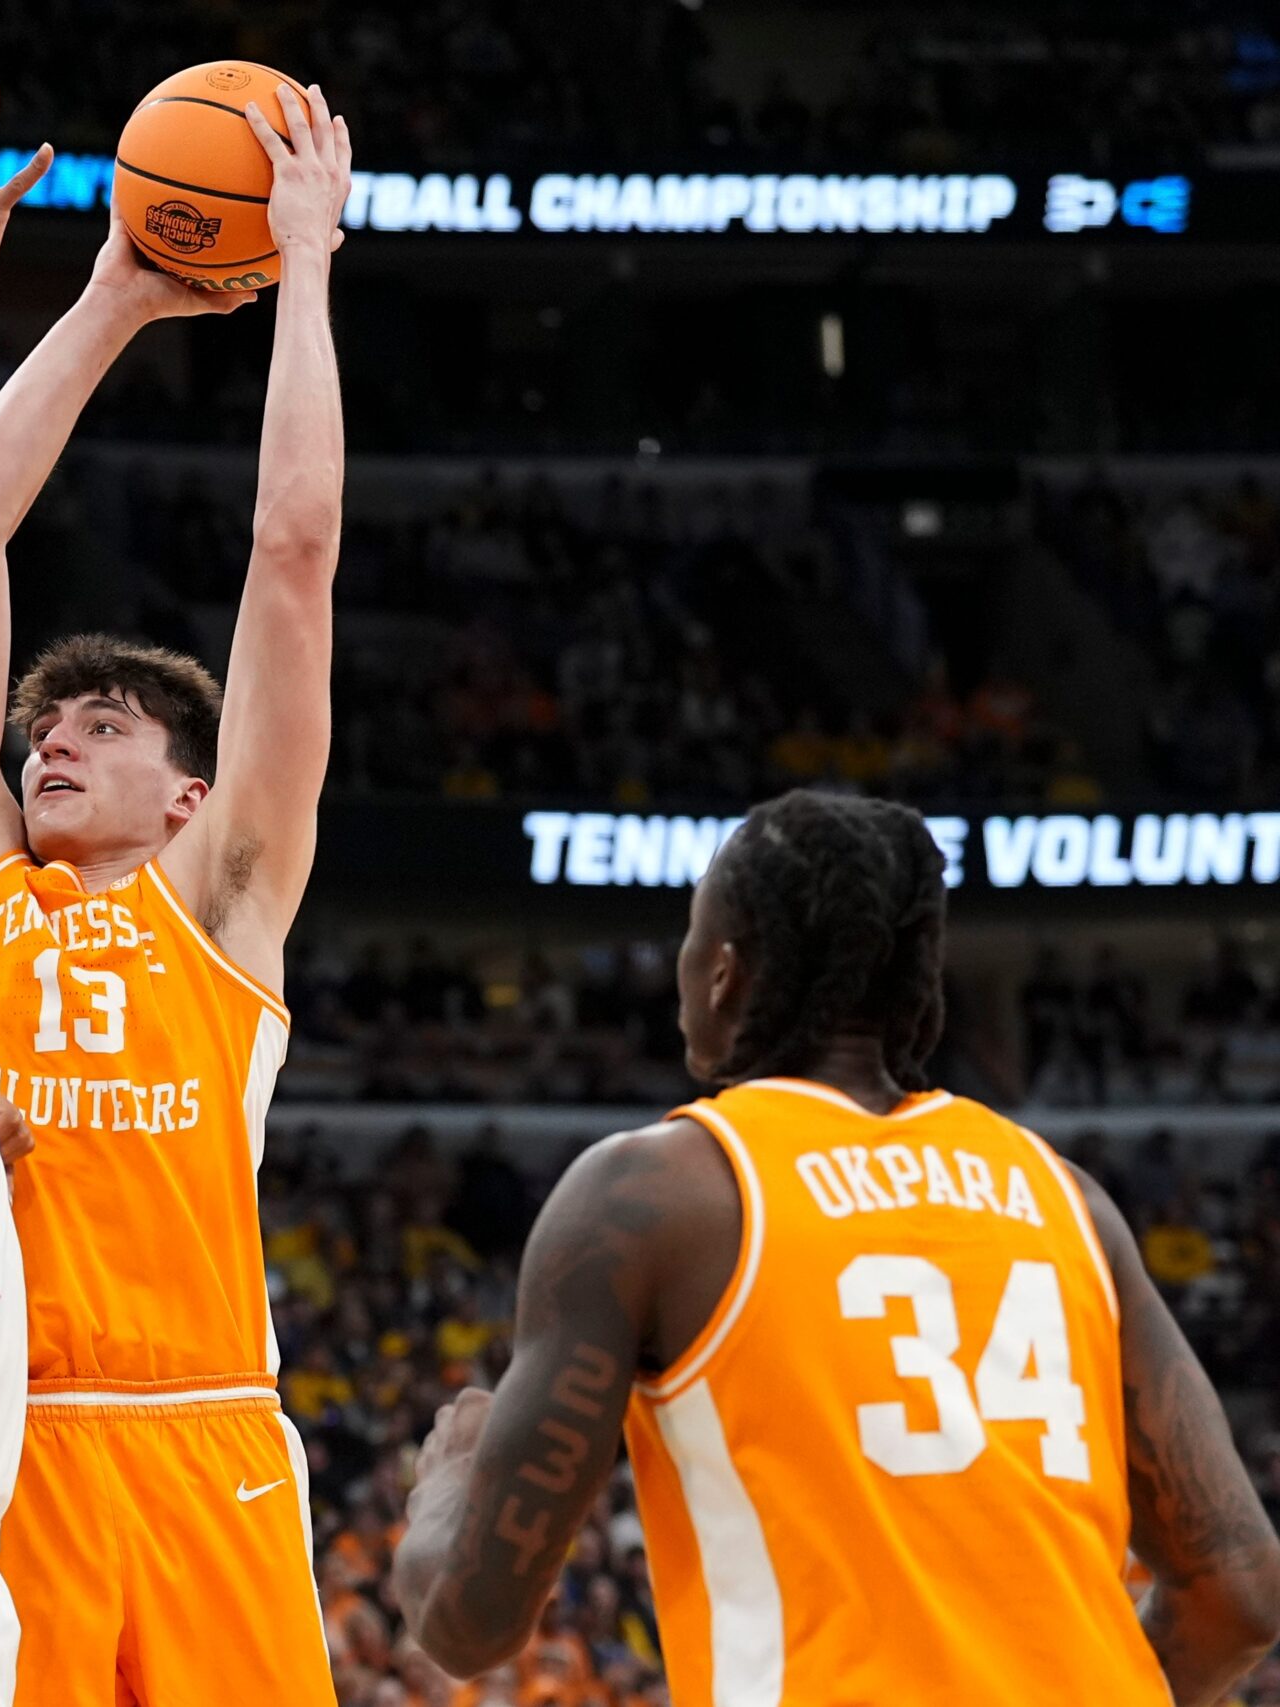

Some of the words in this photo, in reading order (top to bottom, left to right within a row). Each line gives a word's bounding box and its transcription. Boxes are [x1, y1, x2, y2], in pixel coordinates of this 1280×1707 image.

[147, 206, 198, 233] MADNESS
[162, 226, 202, 246] MARCH
[529, 173, 1017, 233] CHAMPIONSHIP
[982, 812, 1280, 888] VOLUNT
[33, 948, 127, 1054] 13
[795, 1144, 1045, 1229] OKPARA
[836, 1253, 1092, 1484] 34
